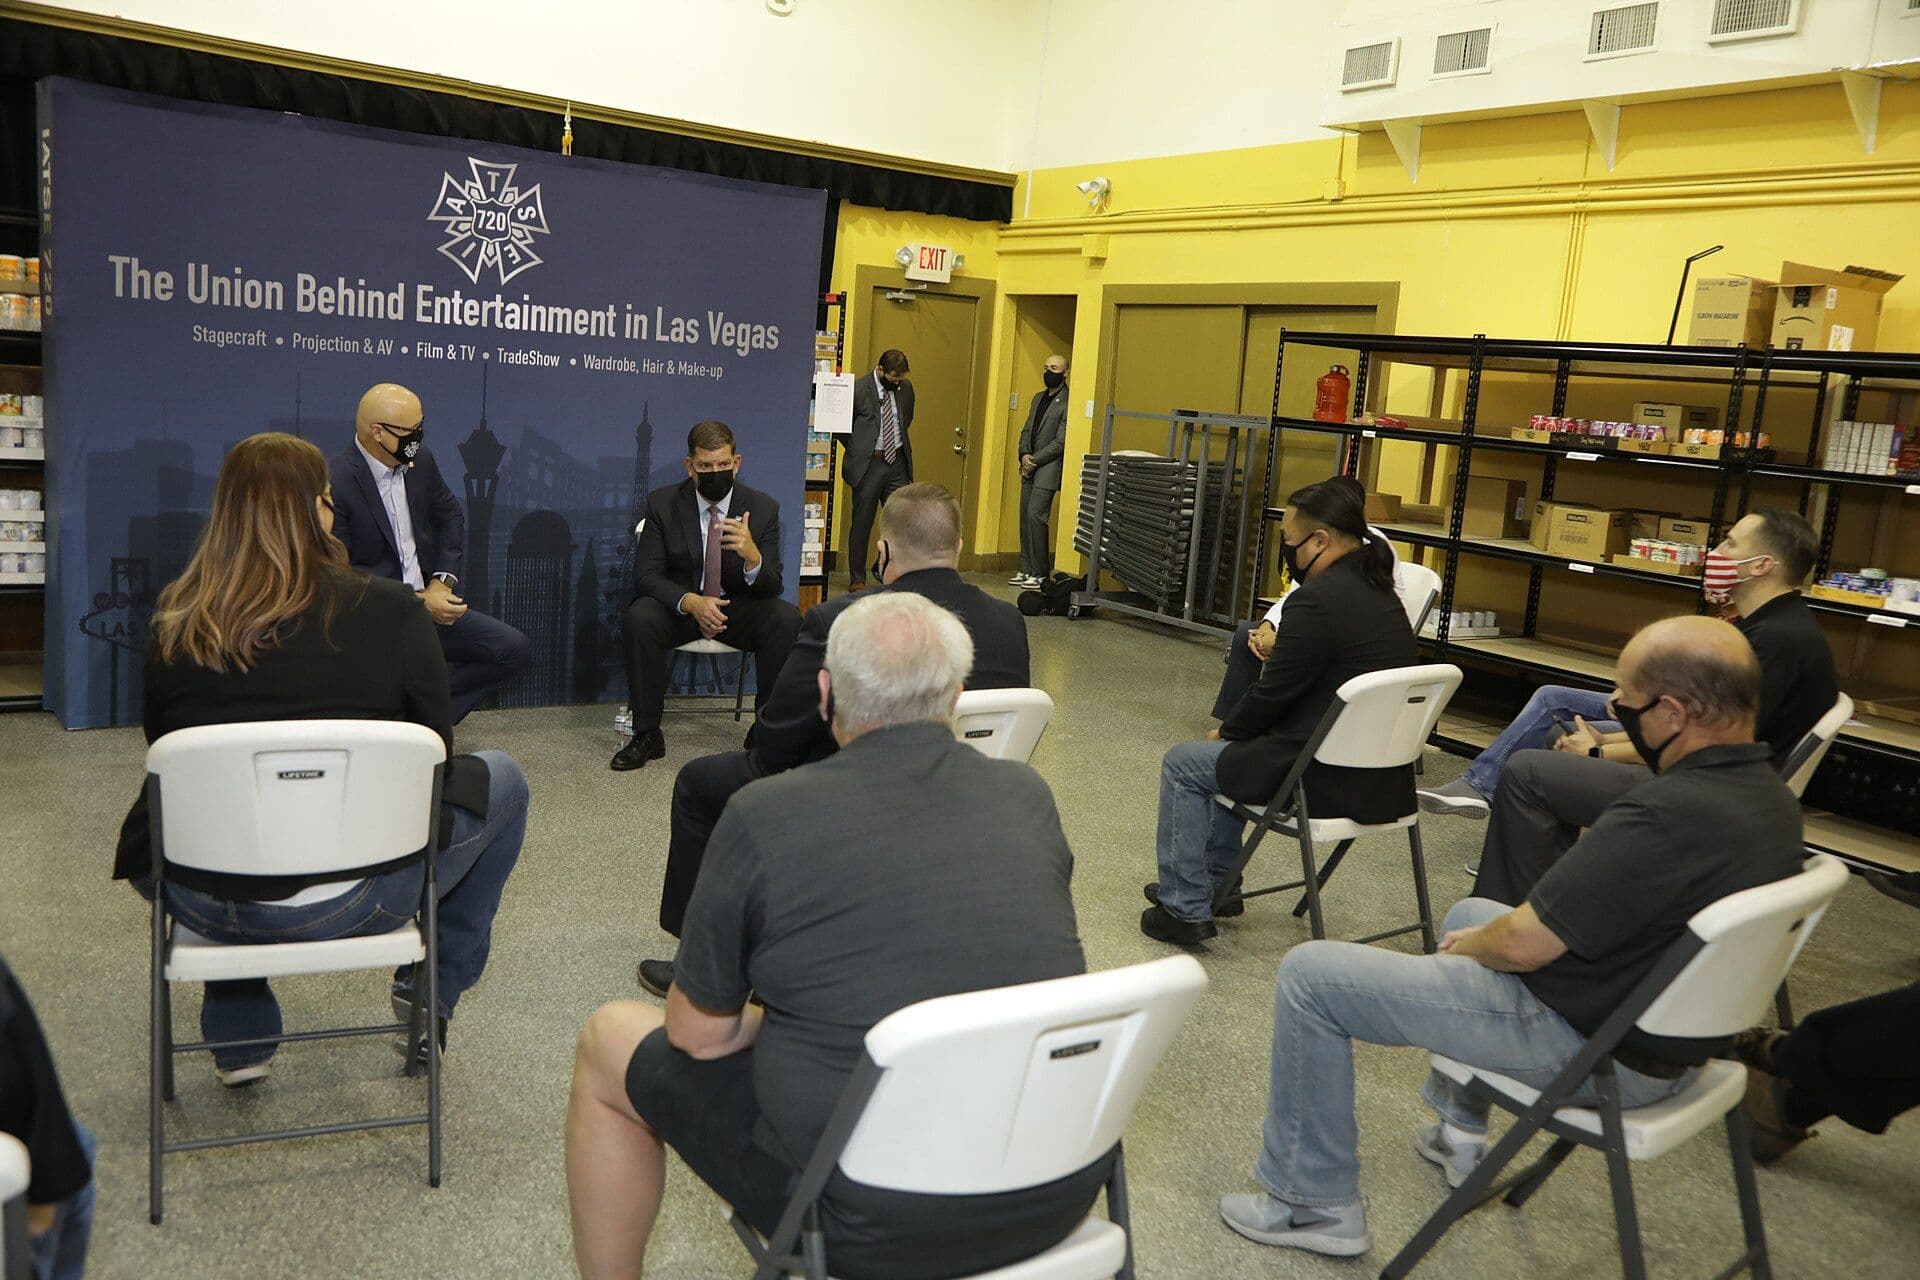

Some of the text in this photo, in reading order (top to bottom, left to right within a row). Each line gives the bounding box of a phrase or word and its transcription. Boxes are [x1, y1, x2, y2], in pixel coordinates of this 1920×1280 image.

[42, 128, 52, 315] IATSE 720
[477, 209, 506, 231] 720
[919, 246, 947, 271] EXIT
[108, 254, 779, 357] The Union Behind Entertainment in Las Vegas
[193, 325, 267, 348] Stagecraft
[293, 333, 394, 356] Projection & AV
[416, 341, 476, 361] Film & TV
[497, 347, 560, 368] TradeShow
[583, 354, 723, 381] Wardrobe, Hair & Make-up
